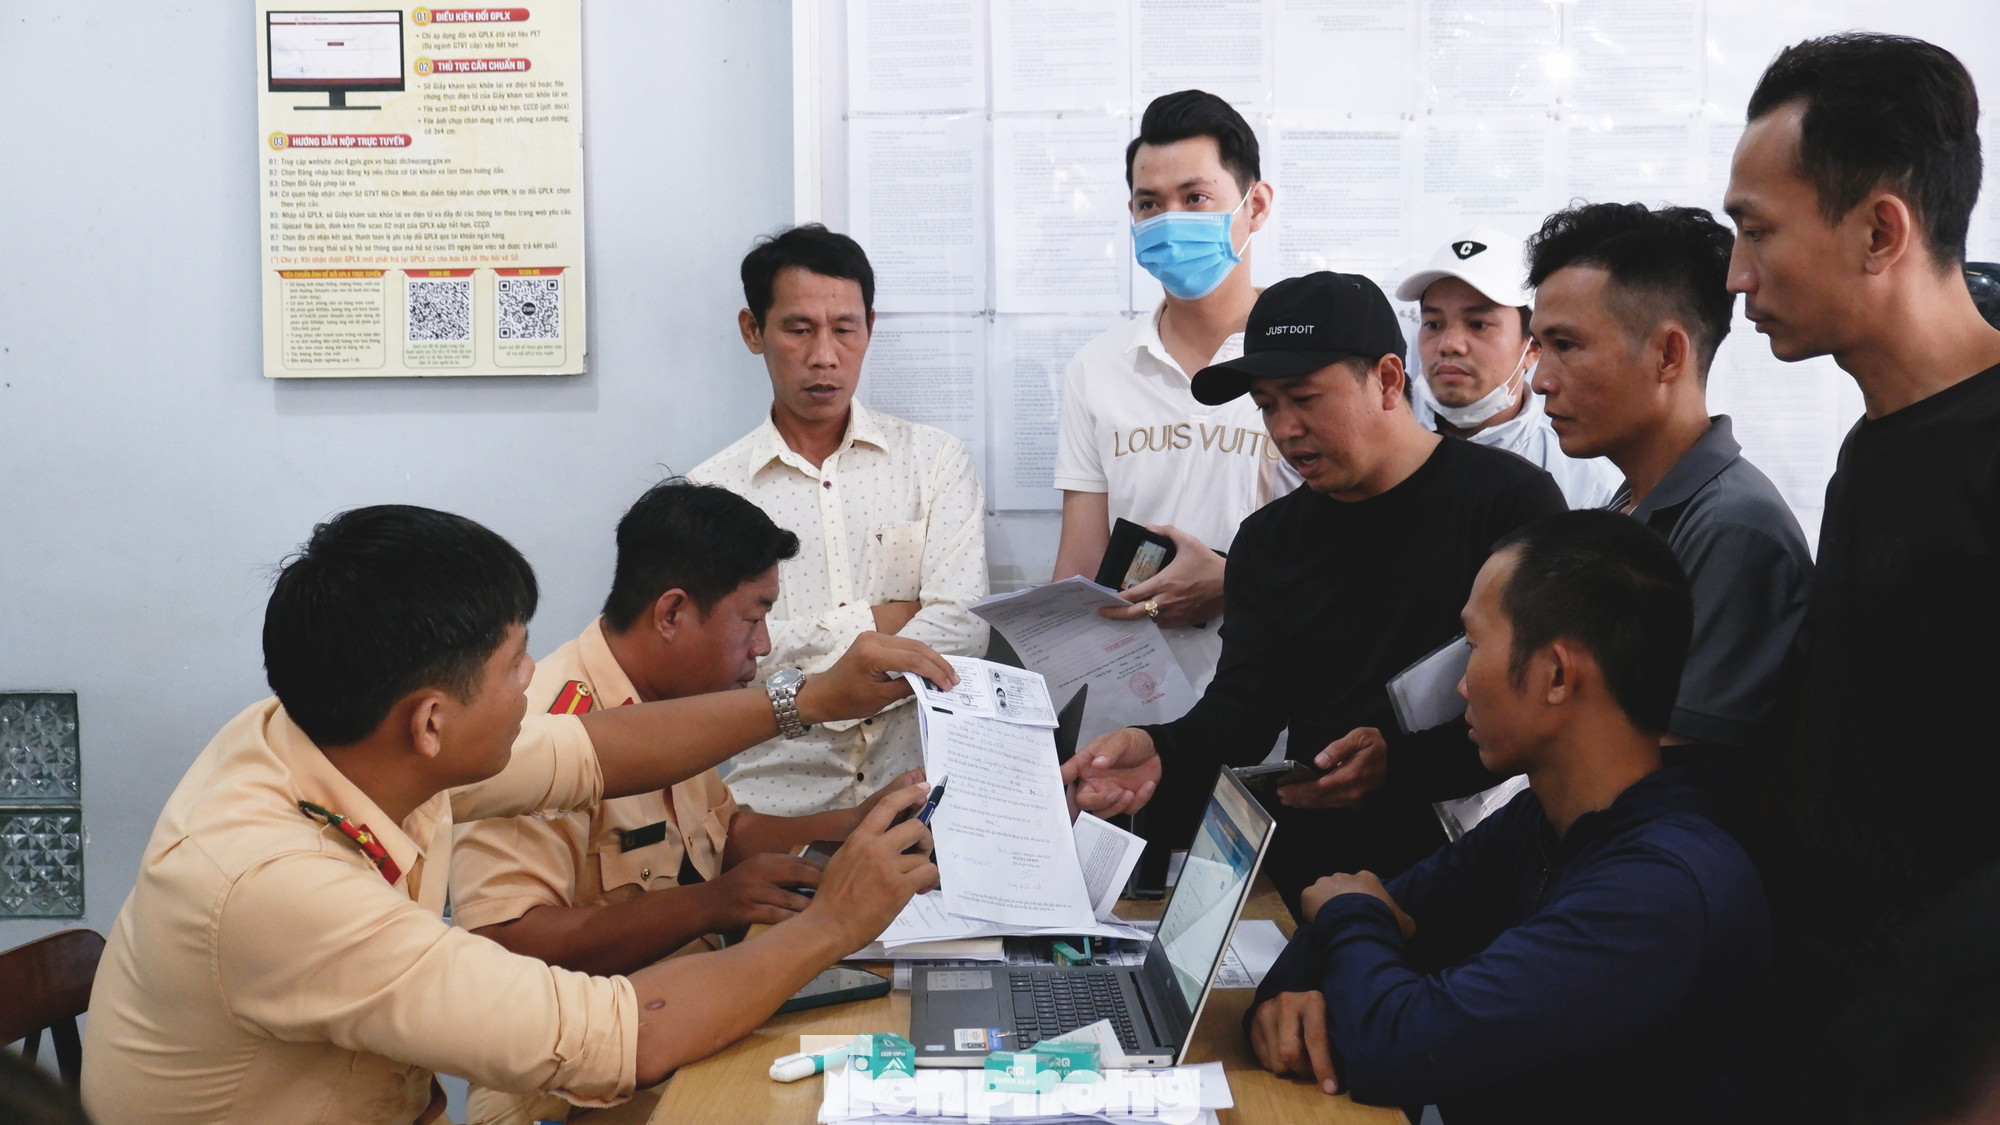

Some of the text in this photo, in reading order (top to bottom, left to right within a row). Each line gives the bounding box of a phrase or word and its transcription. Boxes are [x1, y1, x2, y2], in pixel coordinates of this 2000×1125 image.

[417, 11, 510, 23] 01 ĐIỀU KIỆN ĐỔI GPLX
[419, 60, 525, 73] 02 THỦ TỤC CẦN CHUẨN BỊ
[274, 136, 404, 146] 03 HƯỚNG DẪN NỘP TRỰC TUYẾN
[1460, 242, 1473, 256] C
[1266, 325, 1315, 336] JUST DO IT
[1115, 423, 1192, 457] LOUIS
